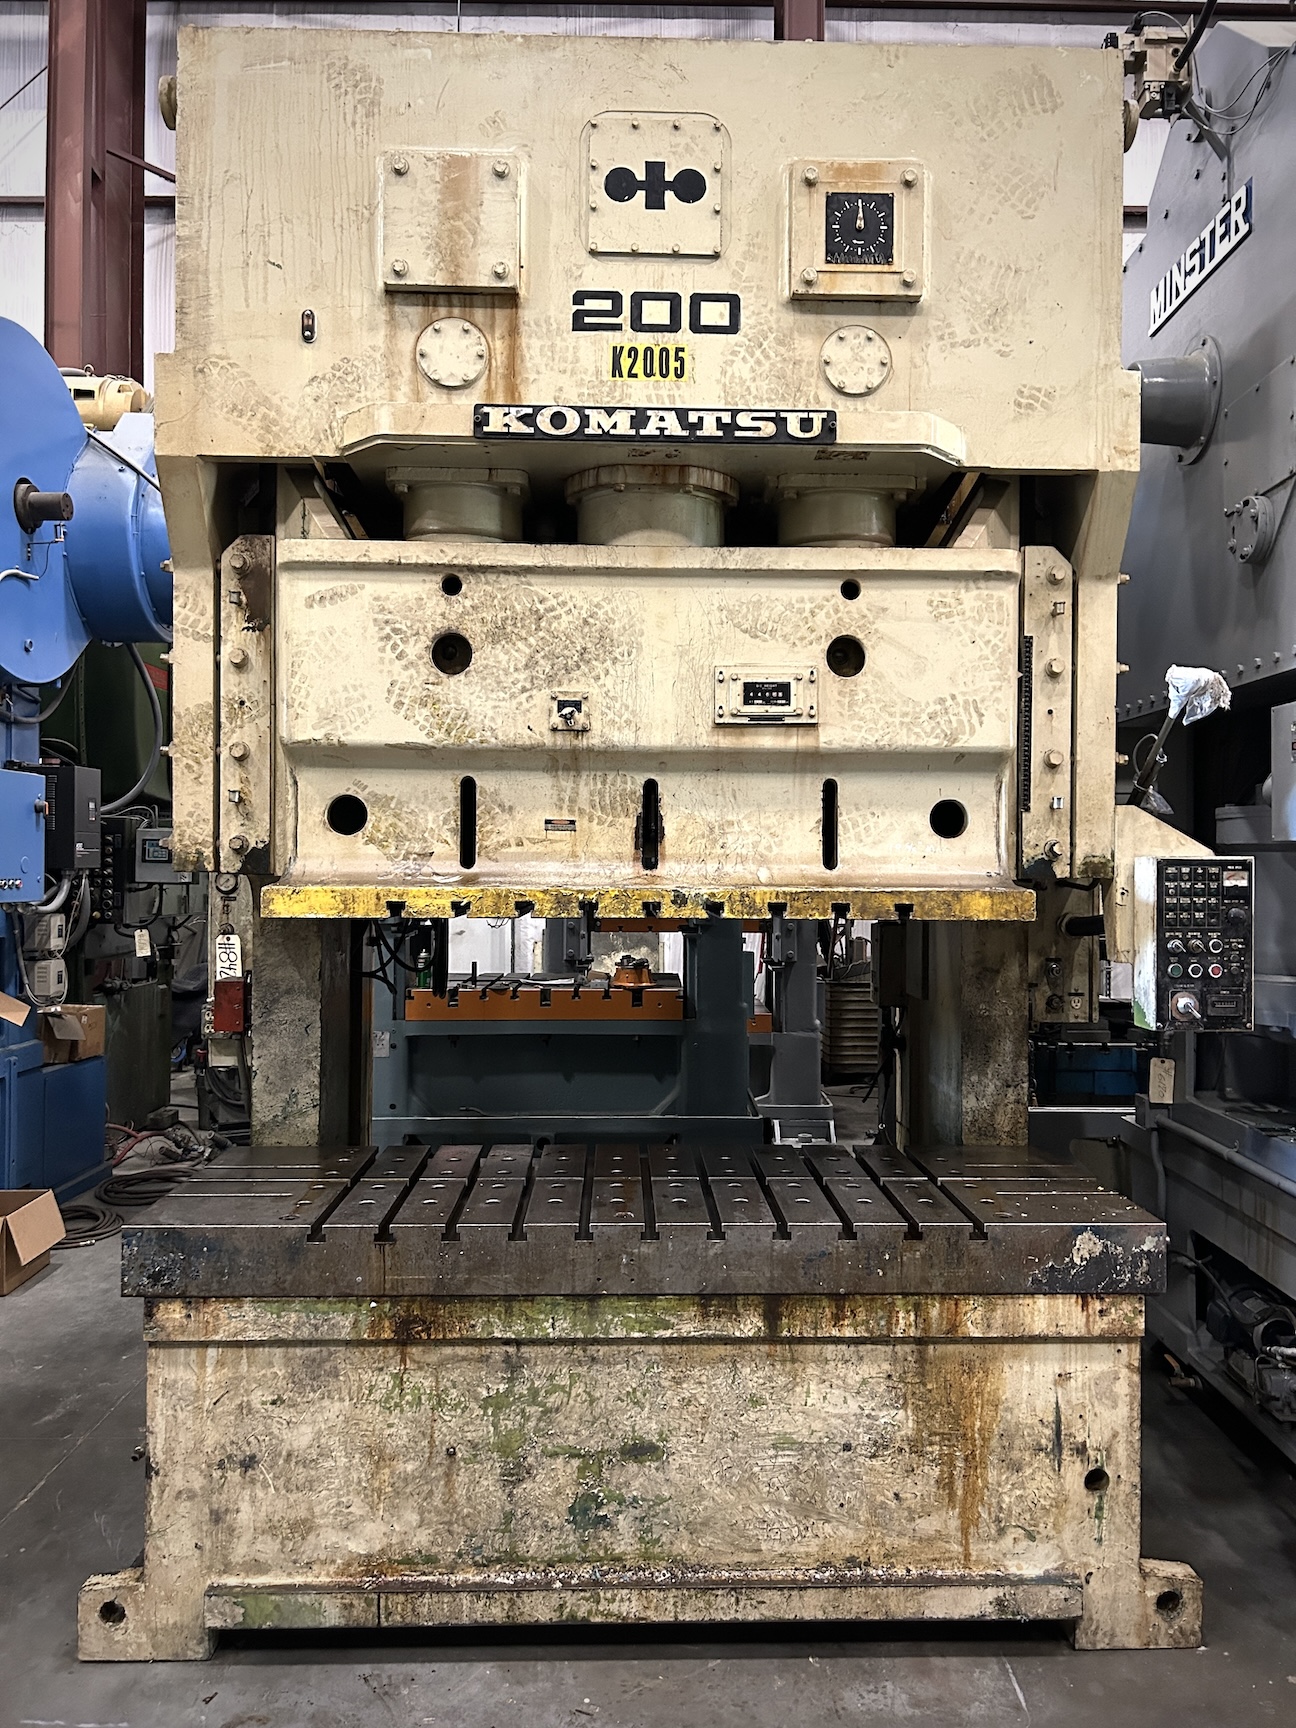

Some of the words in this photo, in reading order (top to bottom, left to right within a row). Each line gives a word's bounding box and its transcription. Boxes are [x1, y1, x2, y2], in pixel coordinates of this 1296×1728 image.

[1148, 185, 1249, 337] MINSTER
[572, 290, 741, 334] 200
[611, 346, 686, 379] K2005
[483, 406, 828, 439] KOMATSU
